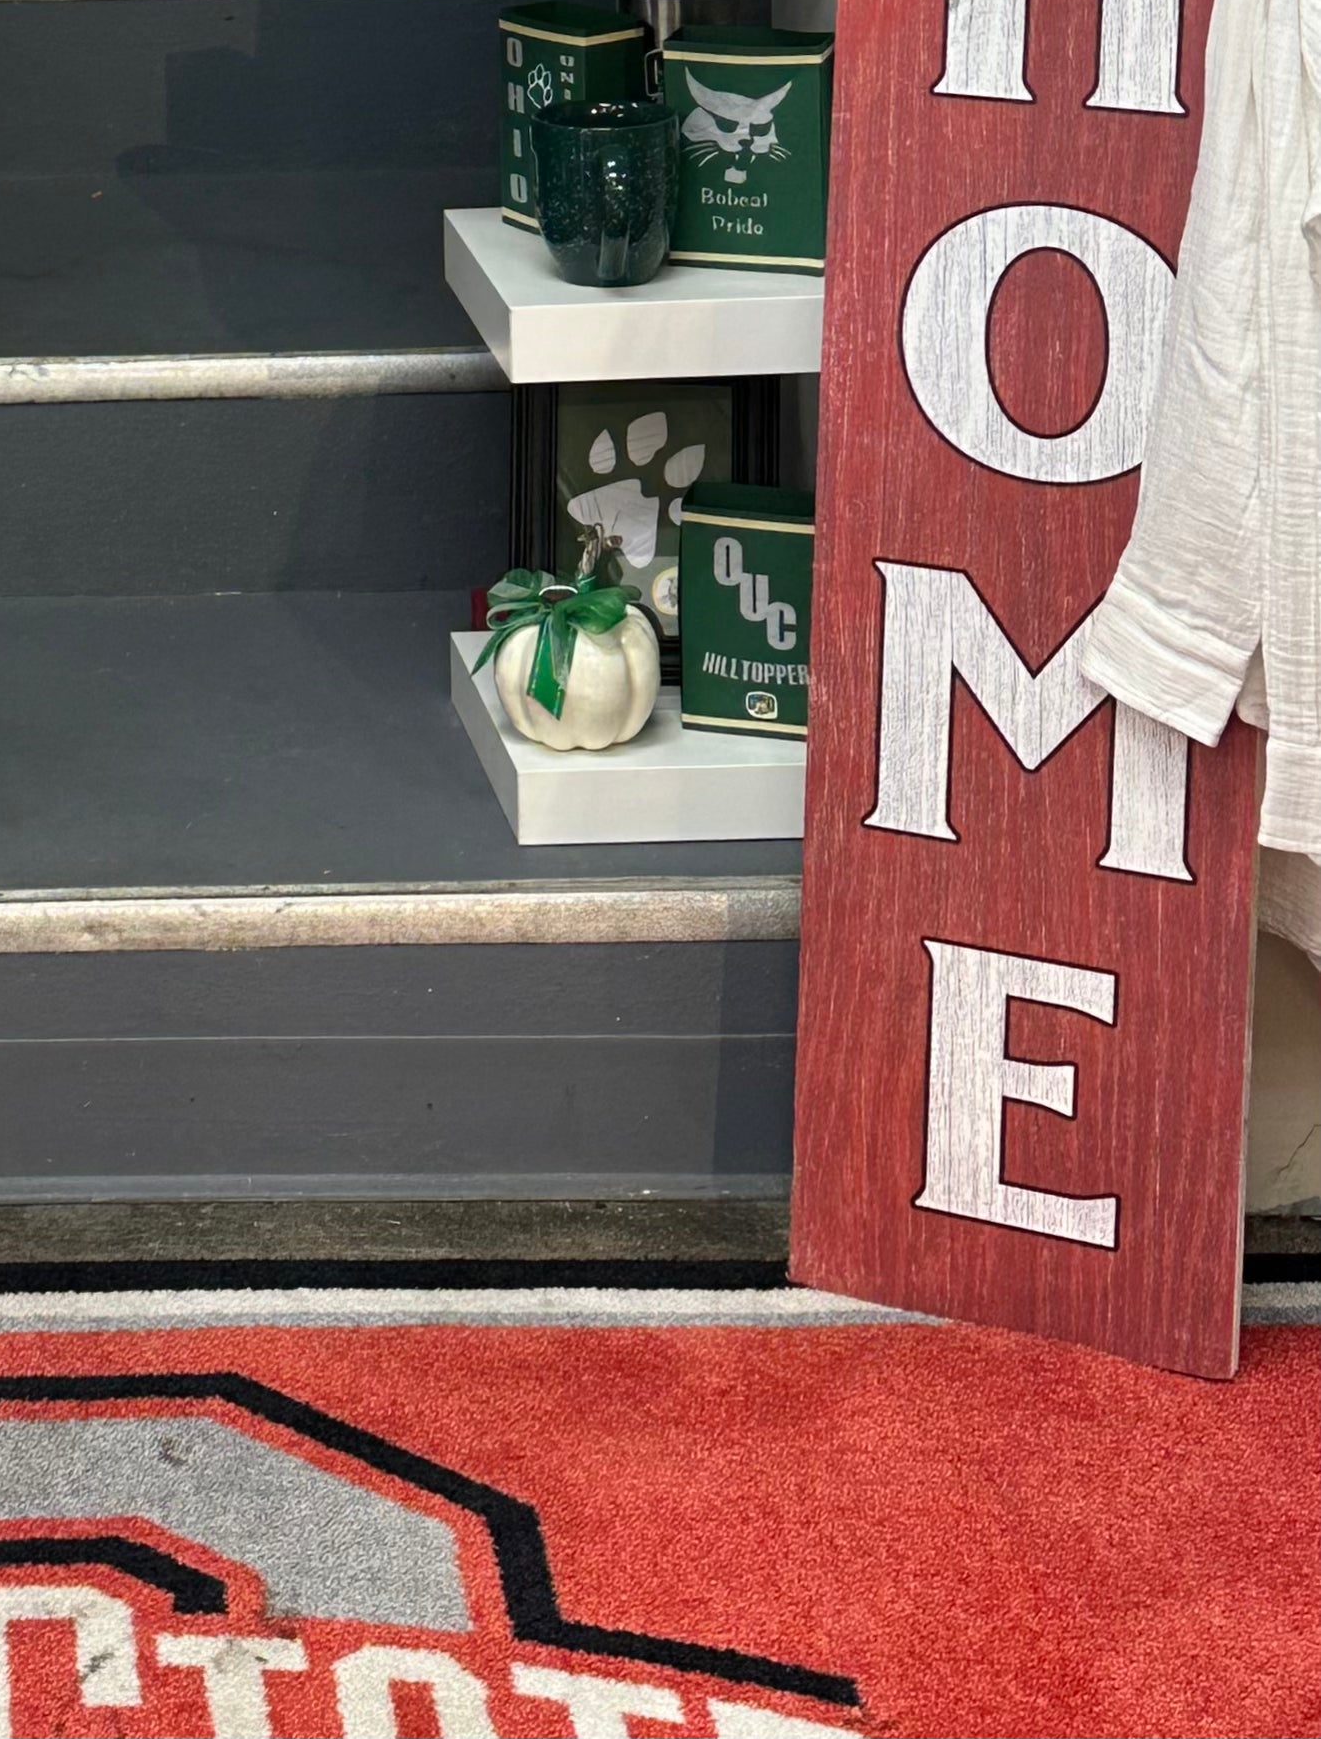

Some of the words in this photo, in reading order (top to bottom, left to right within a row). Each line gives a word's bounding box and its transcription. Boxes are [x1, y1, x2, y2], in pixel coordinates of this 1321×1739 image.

[506, 37, 528, 203] OHIO
[701, 187, 768, 207] Bobcat
[712, 215, 764, 235] Pride
[713, 536, 797, 650] OUC
